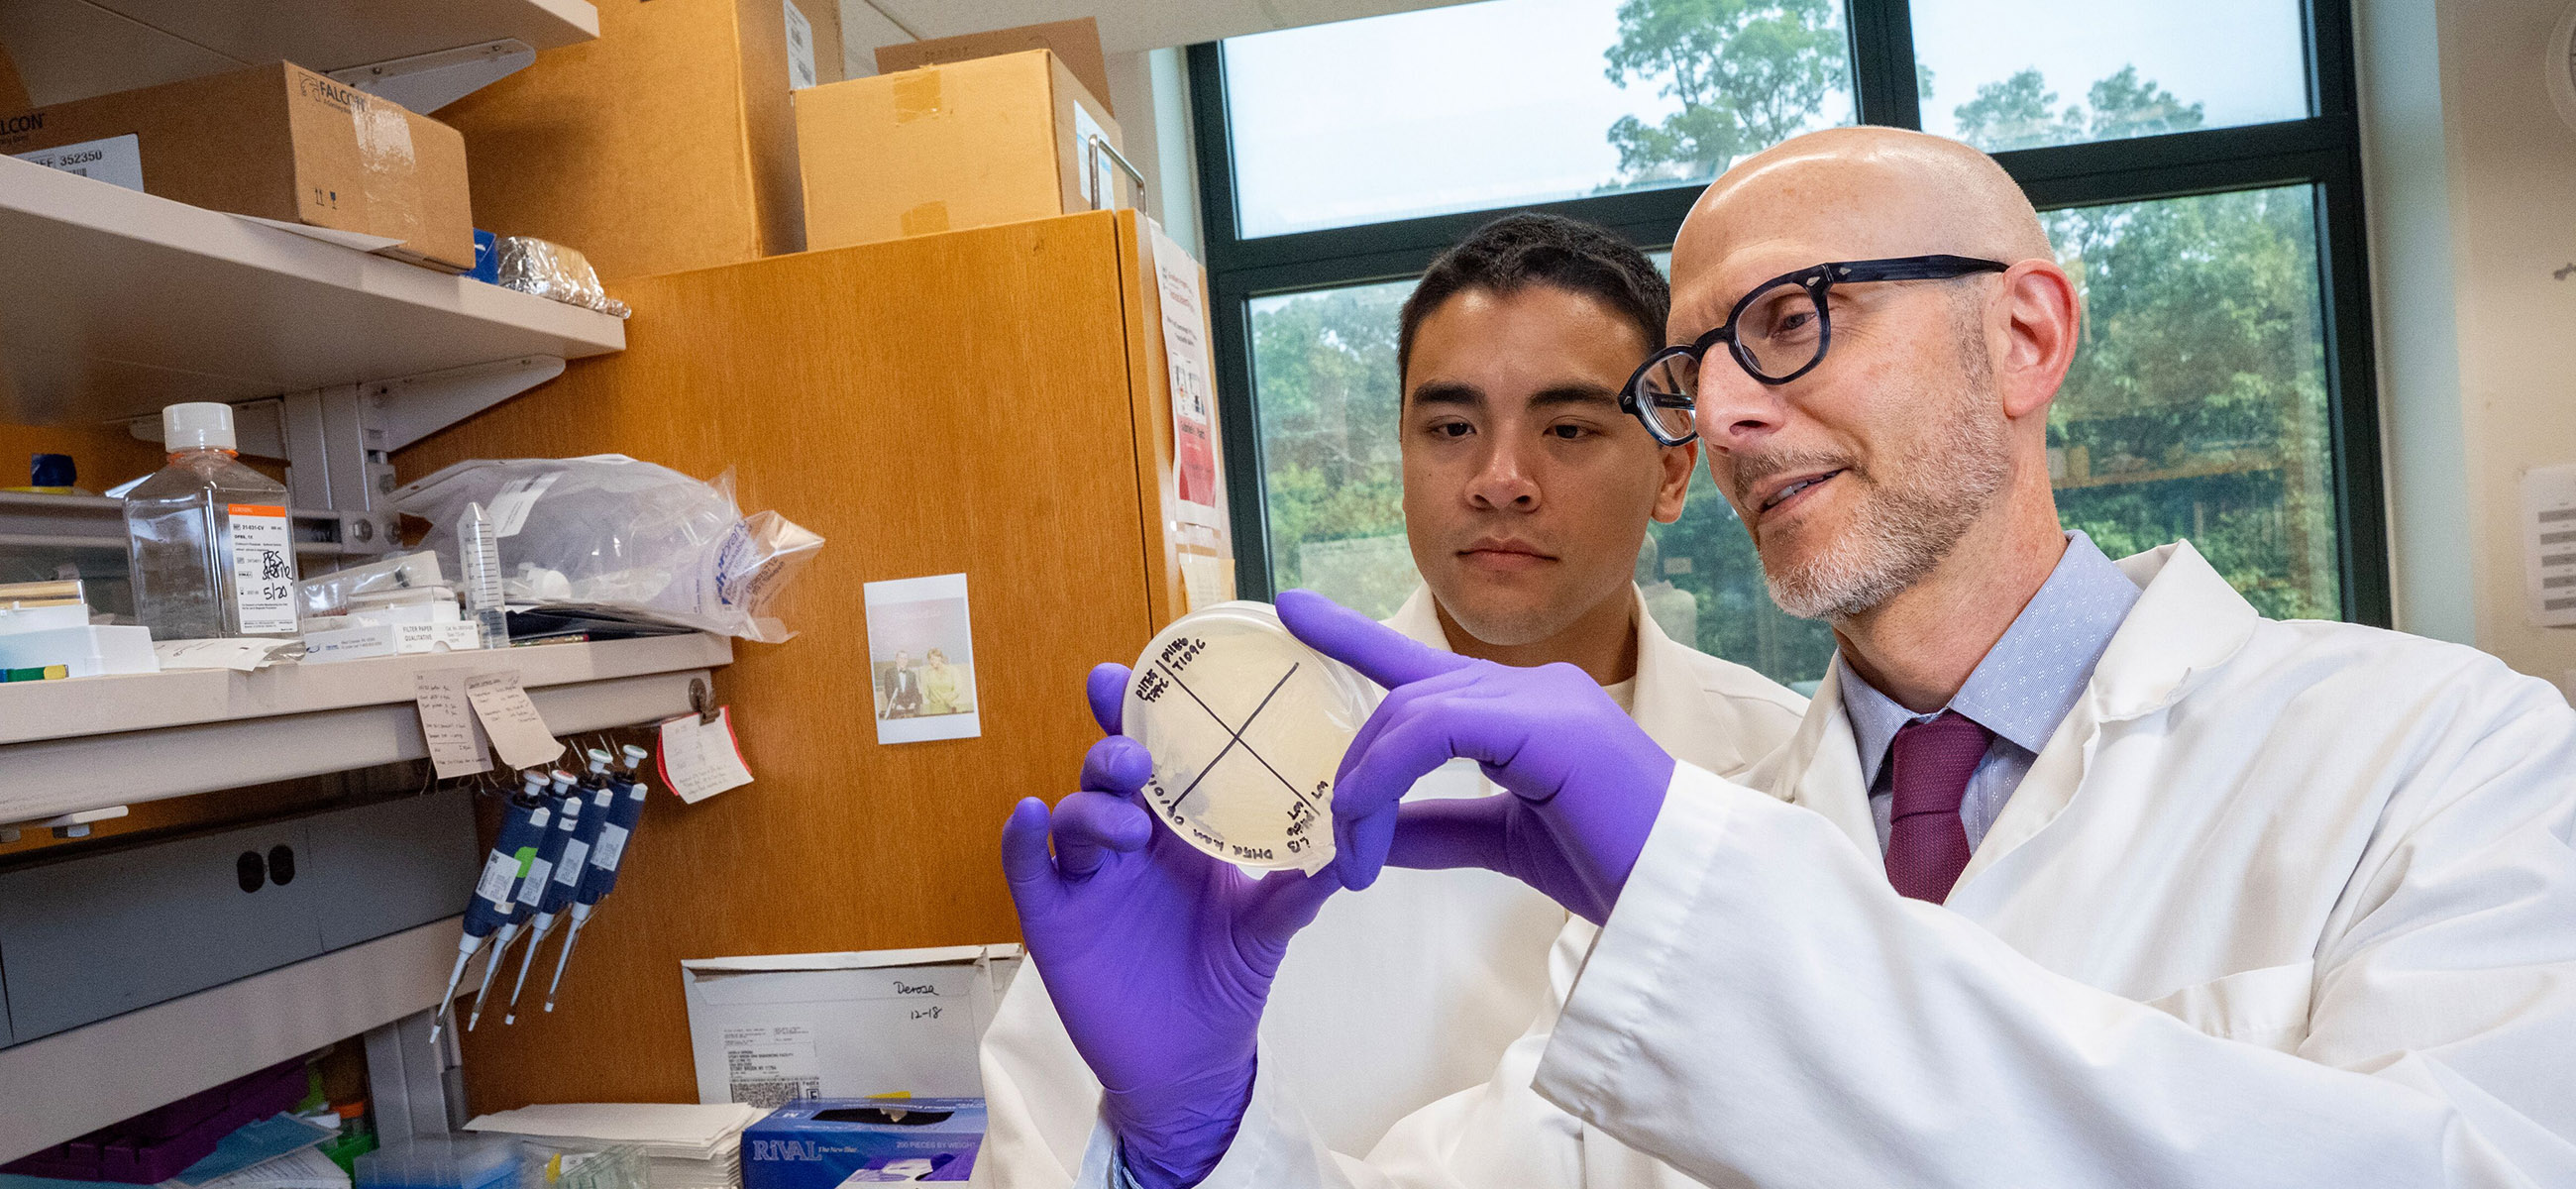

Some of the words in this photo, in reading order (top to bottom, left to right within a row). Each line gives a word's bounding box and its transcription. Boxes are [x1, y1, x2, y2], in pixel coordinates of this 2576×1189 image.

[319, 81, 366, 112] FALCON
[0, 113, 44, 136] LCON
[59, 149, 103, 166] 352350
[263, 583, 287, 600] 5/20
[1172, 638, 1206, 671] T109C
[893, 981, 939, 996] Derosa
[911, 1006, 942, 1020] 12-18
